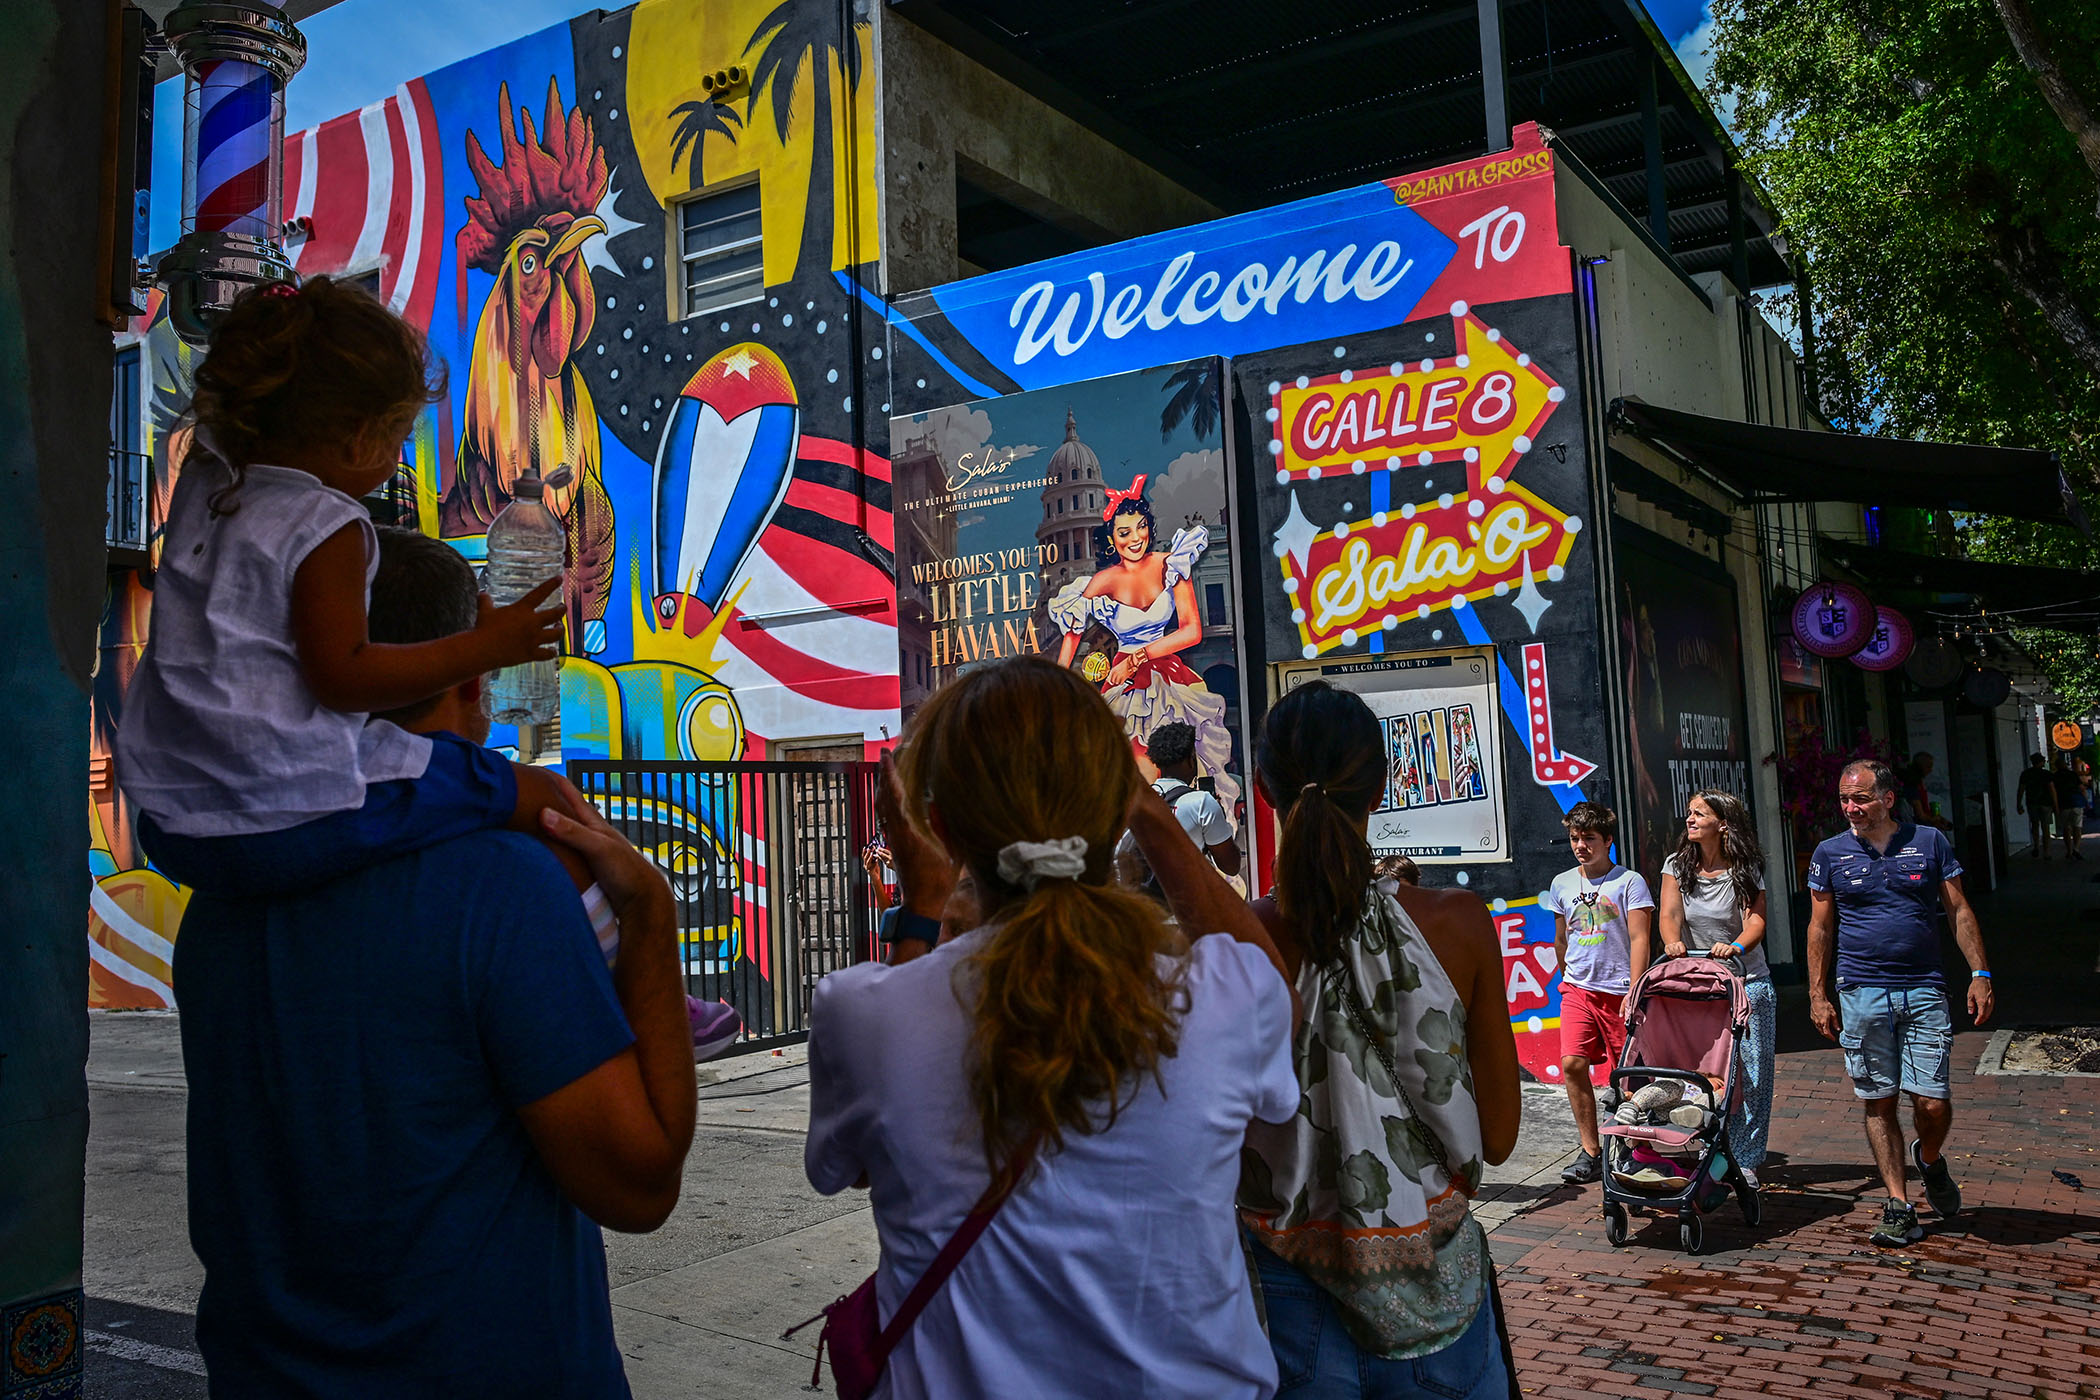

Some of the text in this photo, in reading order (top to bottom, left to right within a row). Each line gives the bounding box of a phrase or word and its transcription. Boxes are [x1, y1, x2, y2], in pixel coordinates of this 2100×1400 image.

[1010, 205, 1526, 365] Welcome TO
[1303, 374, 1512, 450] CALLE 8
[904, 475, 1059, 511] THE ULTIMATE CUBAN EXPERIENCE
[911, 543, 1059, 585] WELCOMES YOU TO
[930, 571, 1038, 624] LITTLE
[930, 616, 1041, 667] HAVANA
[1341, 659, 1428, 673] WELCOMES YOU TO
[1679, 712, 1730, 750] GET SEDUCED BY
[1668, 760, 1690, 818] THE
